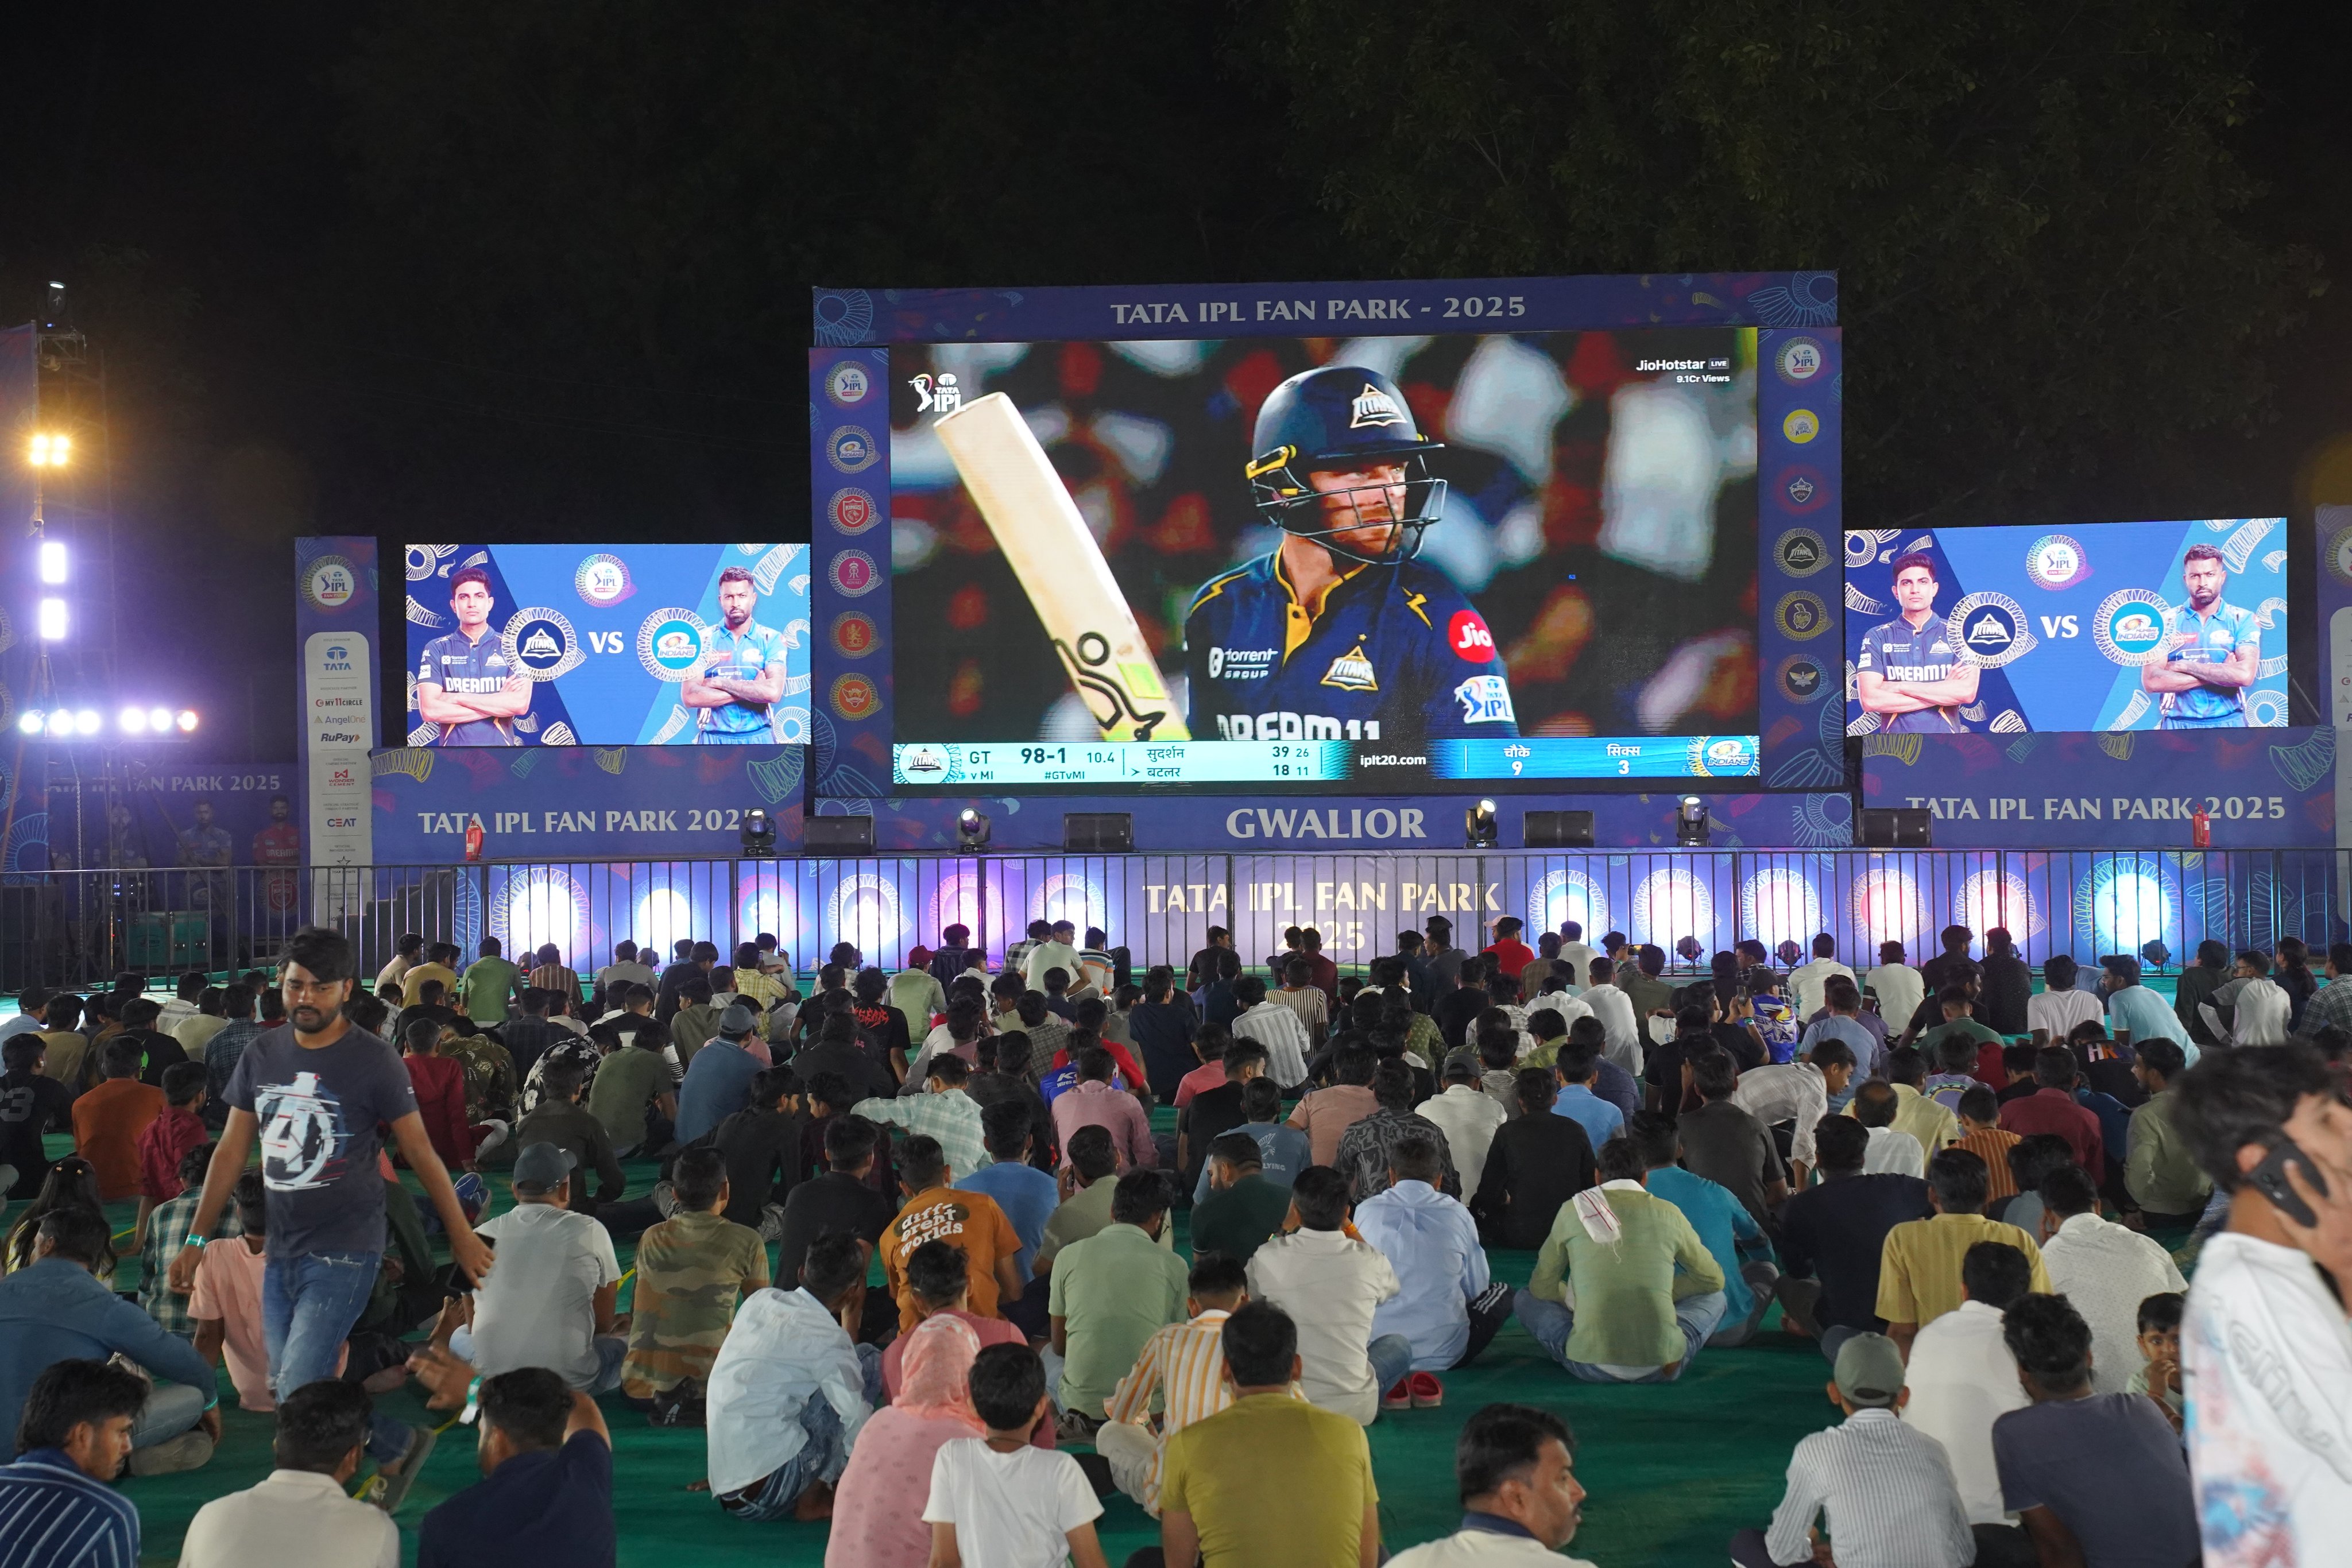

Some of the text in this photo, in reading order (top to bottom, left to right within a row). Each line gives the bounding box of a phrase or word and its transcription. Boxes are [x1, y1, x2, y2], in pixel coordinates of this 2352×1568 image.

[1110, 304, 1189, 324] TATA
[1199, 302, 1245, 322] IPL
[1257, 300, 1316, 321] FAN
[1328, 298, 1411, 320] PARK
[1442, 296, 1526, 318] 2025
[1636, 359, 1705, 371] JioHotstar
[1801, 358, 1815, 367] IPL
[1676, 374, 1730, 383] 9.1Cr Views
[934, 394, 967, 412] IPL
[1791, 548, 1812, 557] TITANS
[2056, 560, 2072, 568] IPL
[331, 582, 348, 591] IPL
[603, 578, 618, 586] IPL
[1972, 624, 2006, 636] TITANS
[2040, 615, 2079, 638] VS
[587, 631, 625, 654] VS
[1458, 622, 1492, 649] Jio
[2117, 633, 2157, 641] INDIANS
[659, 649, 695, 657] INDIANS
[1224, 647, 1279, 662] torrent
[2183, 651, 2210, 659] Lauritz
[323, 663, 351, 671] TATA
[718, 668, 742, 676] Lauritz
[1329, 660, 1375, 682] TITANS
[1886, 664, 1952, 682] DREAM11
[1224, 669, 1269, 680] GROUP
[444, 676, 506, 693] DREAM11
[1485, 700, 1512, 717] IPL
[325, 715, 366, 725] AngelOne
[320, 733, 355, 744] RuPay
[969, 748, 1115, 764] GT 98-1 10.4
[1147, 746, 1185, 762] सुदर्शन
[1272, 746, 1309, 757] 39 26
[1503, 744, 1531, 758] चौके
[1606, 743, 1642, 757] सिक्स
[1360, 754, 1427, 768] iplt20.com
[1618, 760, 1630, 775] 3
[1707, 757, 1751, 766] INDIANS
[981, 771, 993, 780] MI
[1045, 771, 1085, 780] #GTvMI
[1147, 767, 1181, 777] बटलर
[1272, 764, 1309, 776] 18 11
[1511, 761, 1523, 776] 9
[172, 776, 224, 791] PARK
[230, 775, 280, 791] 2025
[1989, 798, 2034, 820] IPL
[2044, 797, 2101, 820] FAN
[2113, 797, 2193, 819] PARK
[2203, 796, 2285, 819] 2025
[327, 818, 357, 827] CEAT
[417, 809, 751, 834] TATA IPL FAN PARK 202
[1226, 808, 1427, 839] GWALIOR
[1143, 882, 1500, 913] TATA IPL FAN PARK
[1276, 921, 1365, 950] 225
[2087, 1042, 2122, 1063] HR
[1057, 1079, 1072, 1088] Wires
[0, 1086, 34, 1122] 3
[1263, 1163, 1286, 1171] LYING
[902, 1202, 953, 1230] diff-
[900, 1208, 957, 1242] erent
[900, 1221, 964, 1257] worlds
